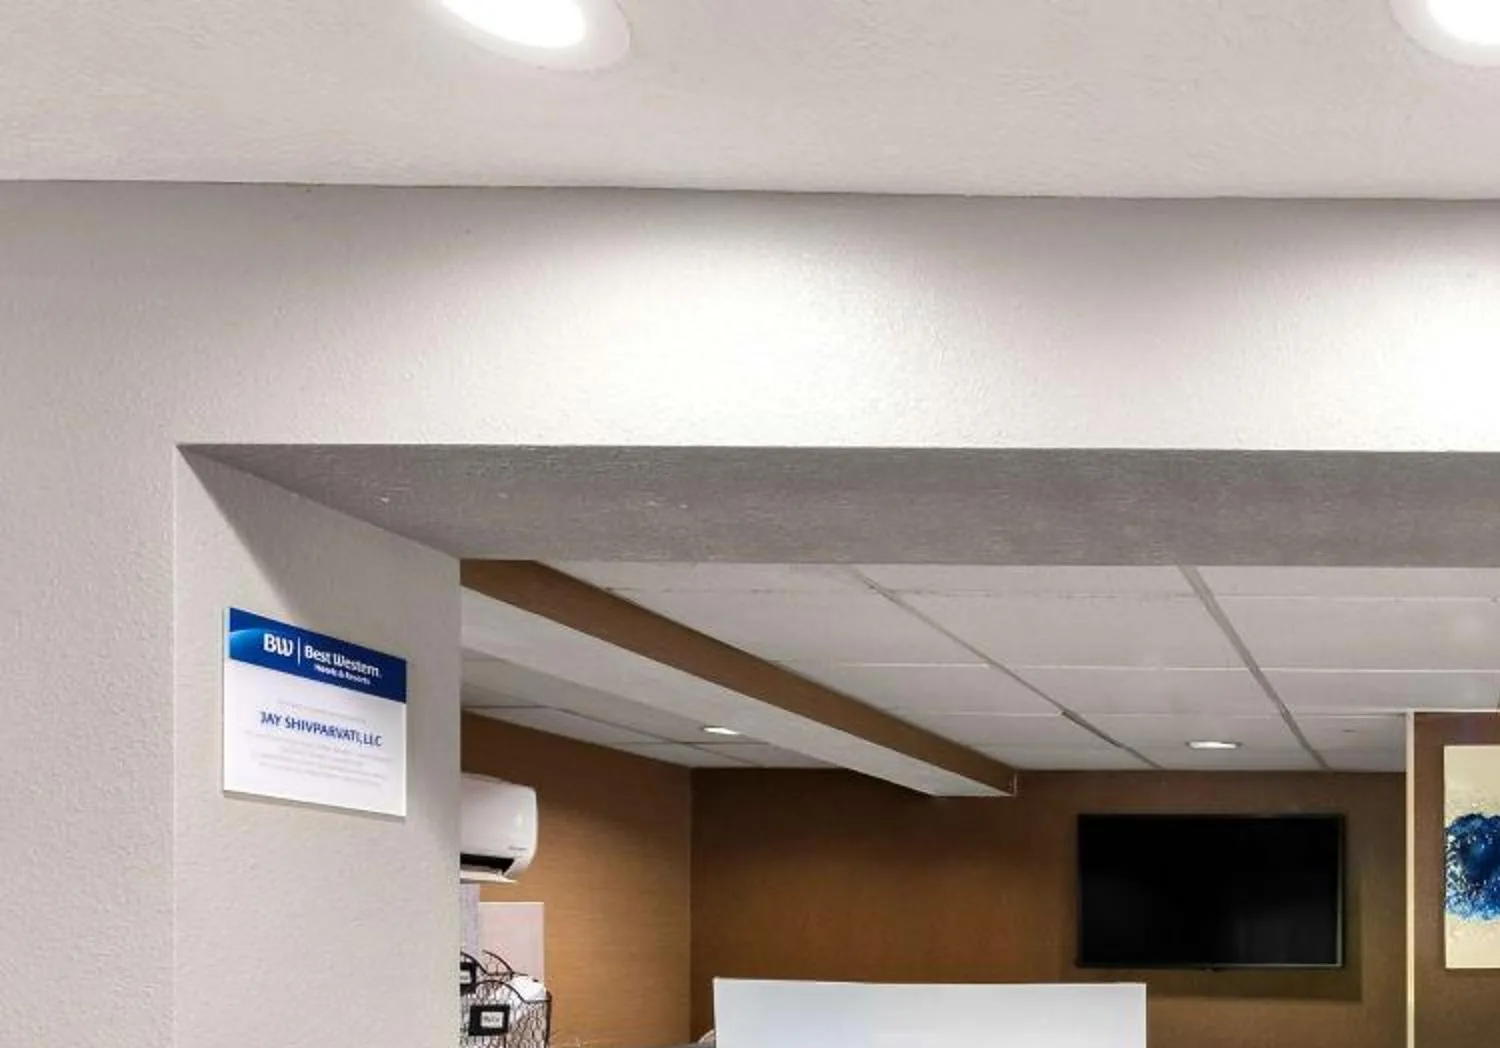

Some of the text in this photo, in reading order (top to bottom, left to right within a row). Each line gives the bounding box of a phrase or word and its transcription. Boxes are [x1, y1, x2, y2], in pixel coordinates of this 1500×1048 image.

[263, 633, 294, 657] BW
[304, 645, 380, 677] Best Western
[260, 711, 282, 726] JAY
